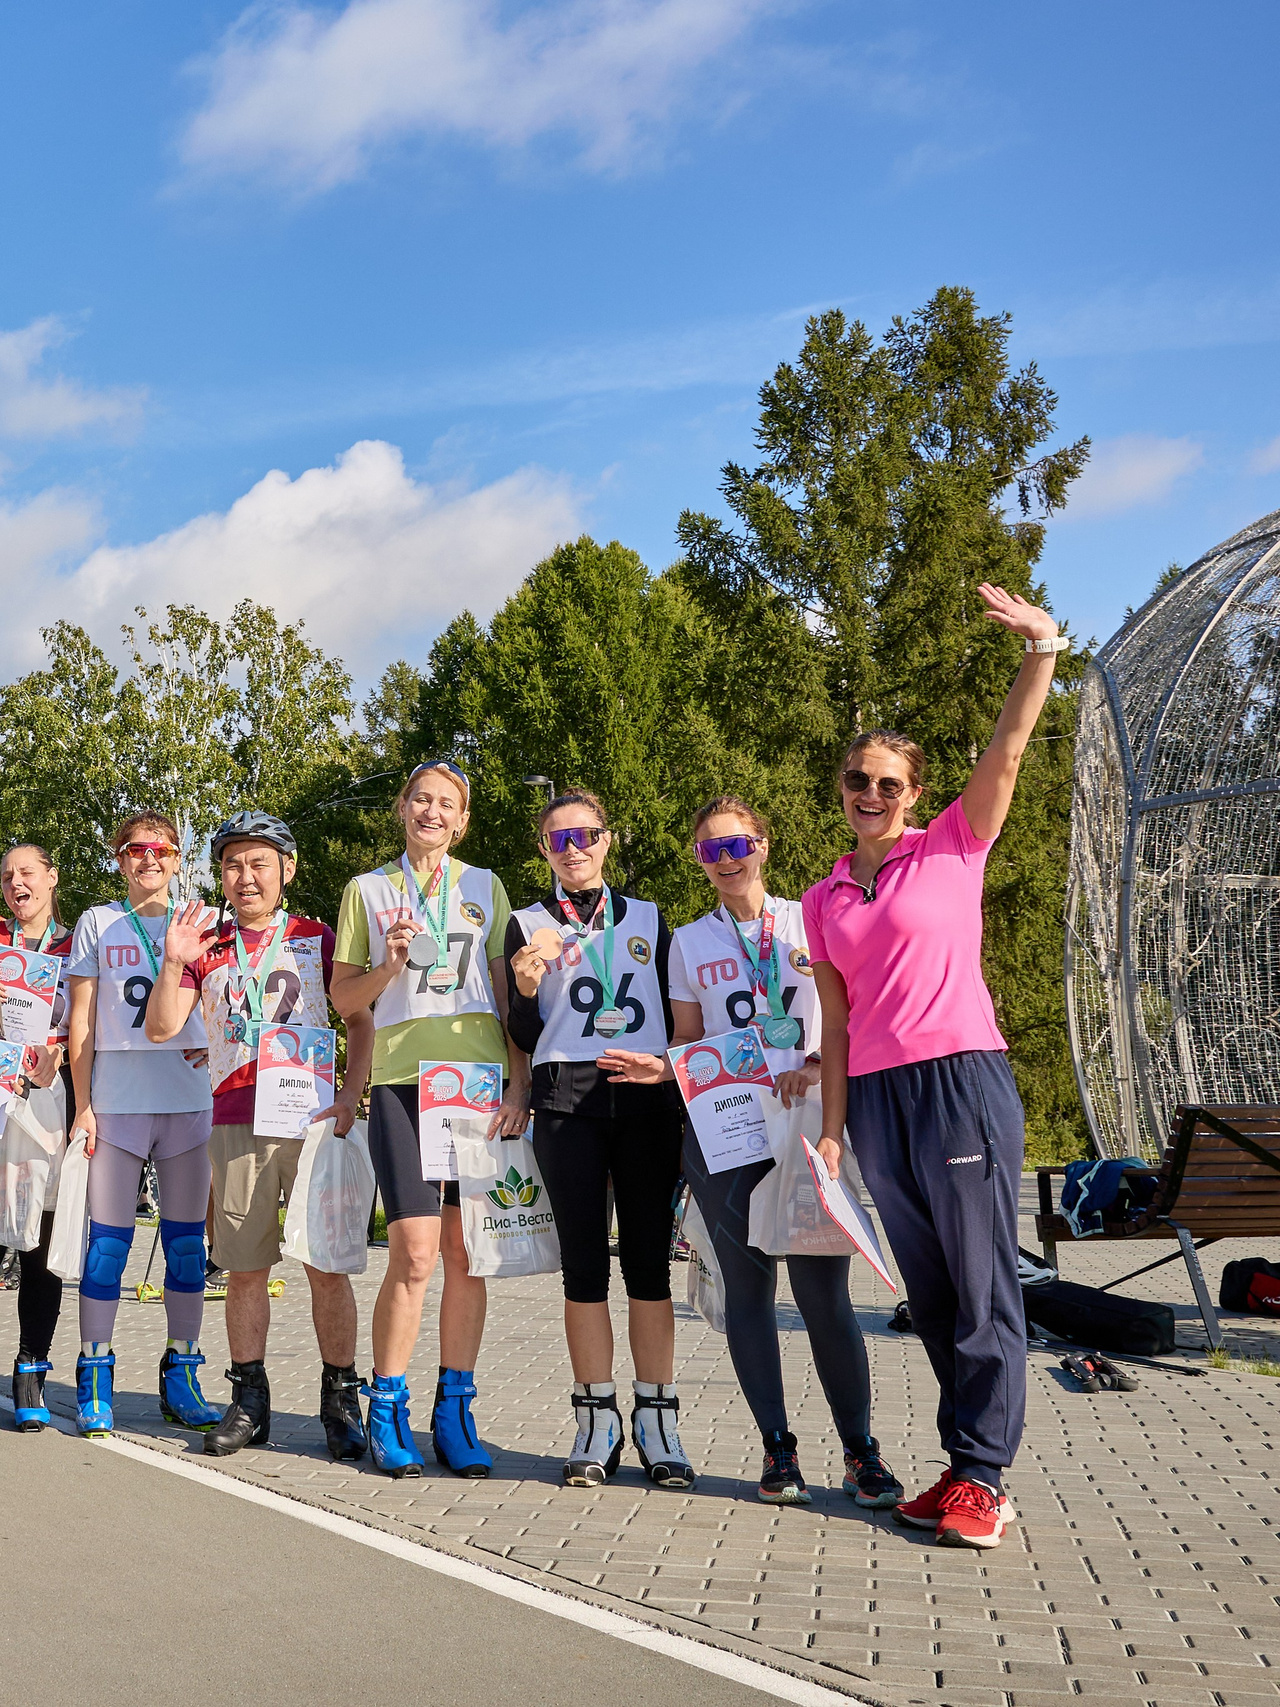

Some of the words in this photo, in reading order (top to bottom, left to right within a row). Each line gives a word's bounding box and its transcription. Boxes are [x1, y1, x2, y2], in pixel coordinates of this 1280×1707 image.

[105, 945, 141, 968] ГТО
[696, 957, 739, 990] ГТО
[5, 997, 33, 1009] ИПЛОМ
[124, 976, 154, 1028] 9
[570, 973, 646, 1038] 96
[685, 1066, 714, 1080] SKI_LOVE
[695, 1076, 711, 1087] 2025
[279, 1078, 312, 1089] ДИПЛОМ
[427, 1085, 453, 1095] SKI_LOVE
[433, 1094, 447, 1102] 2025
[714, 1093, 753, 1113] ДИПЛОМ
[483, 1212, 553, 1232] Диа-Веста
